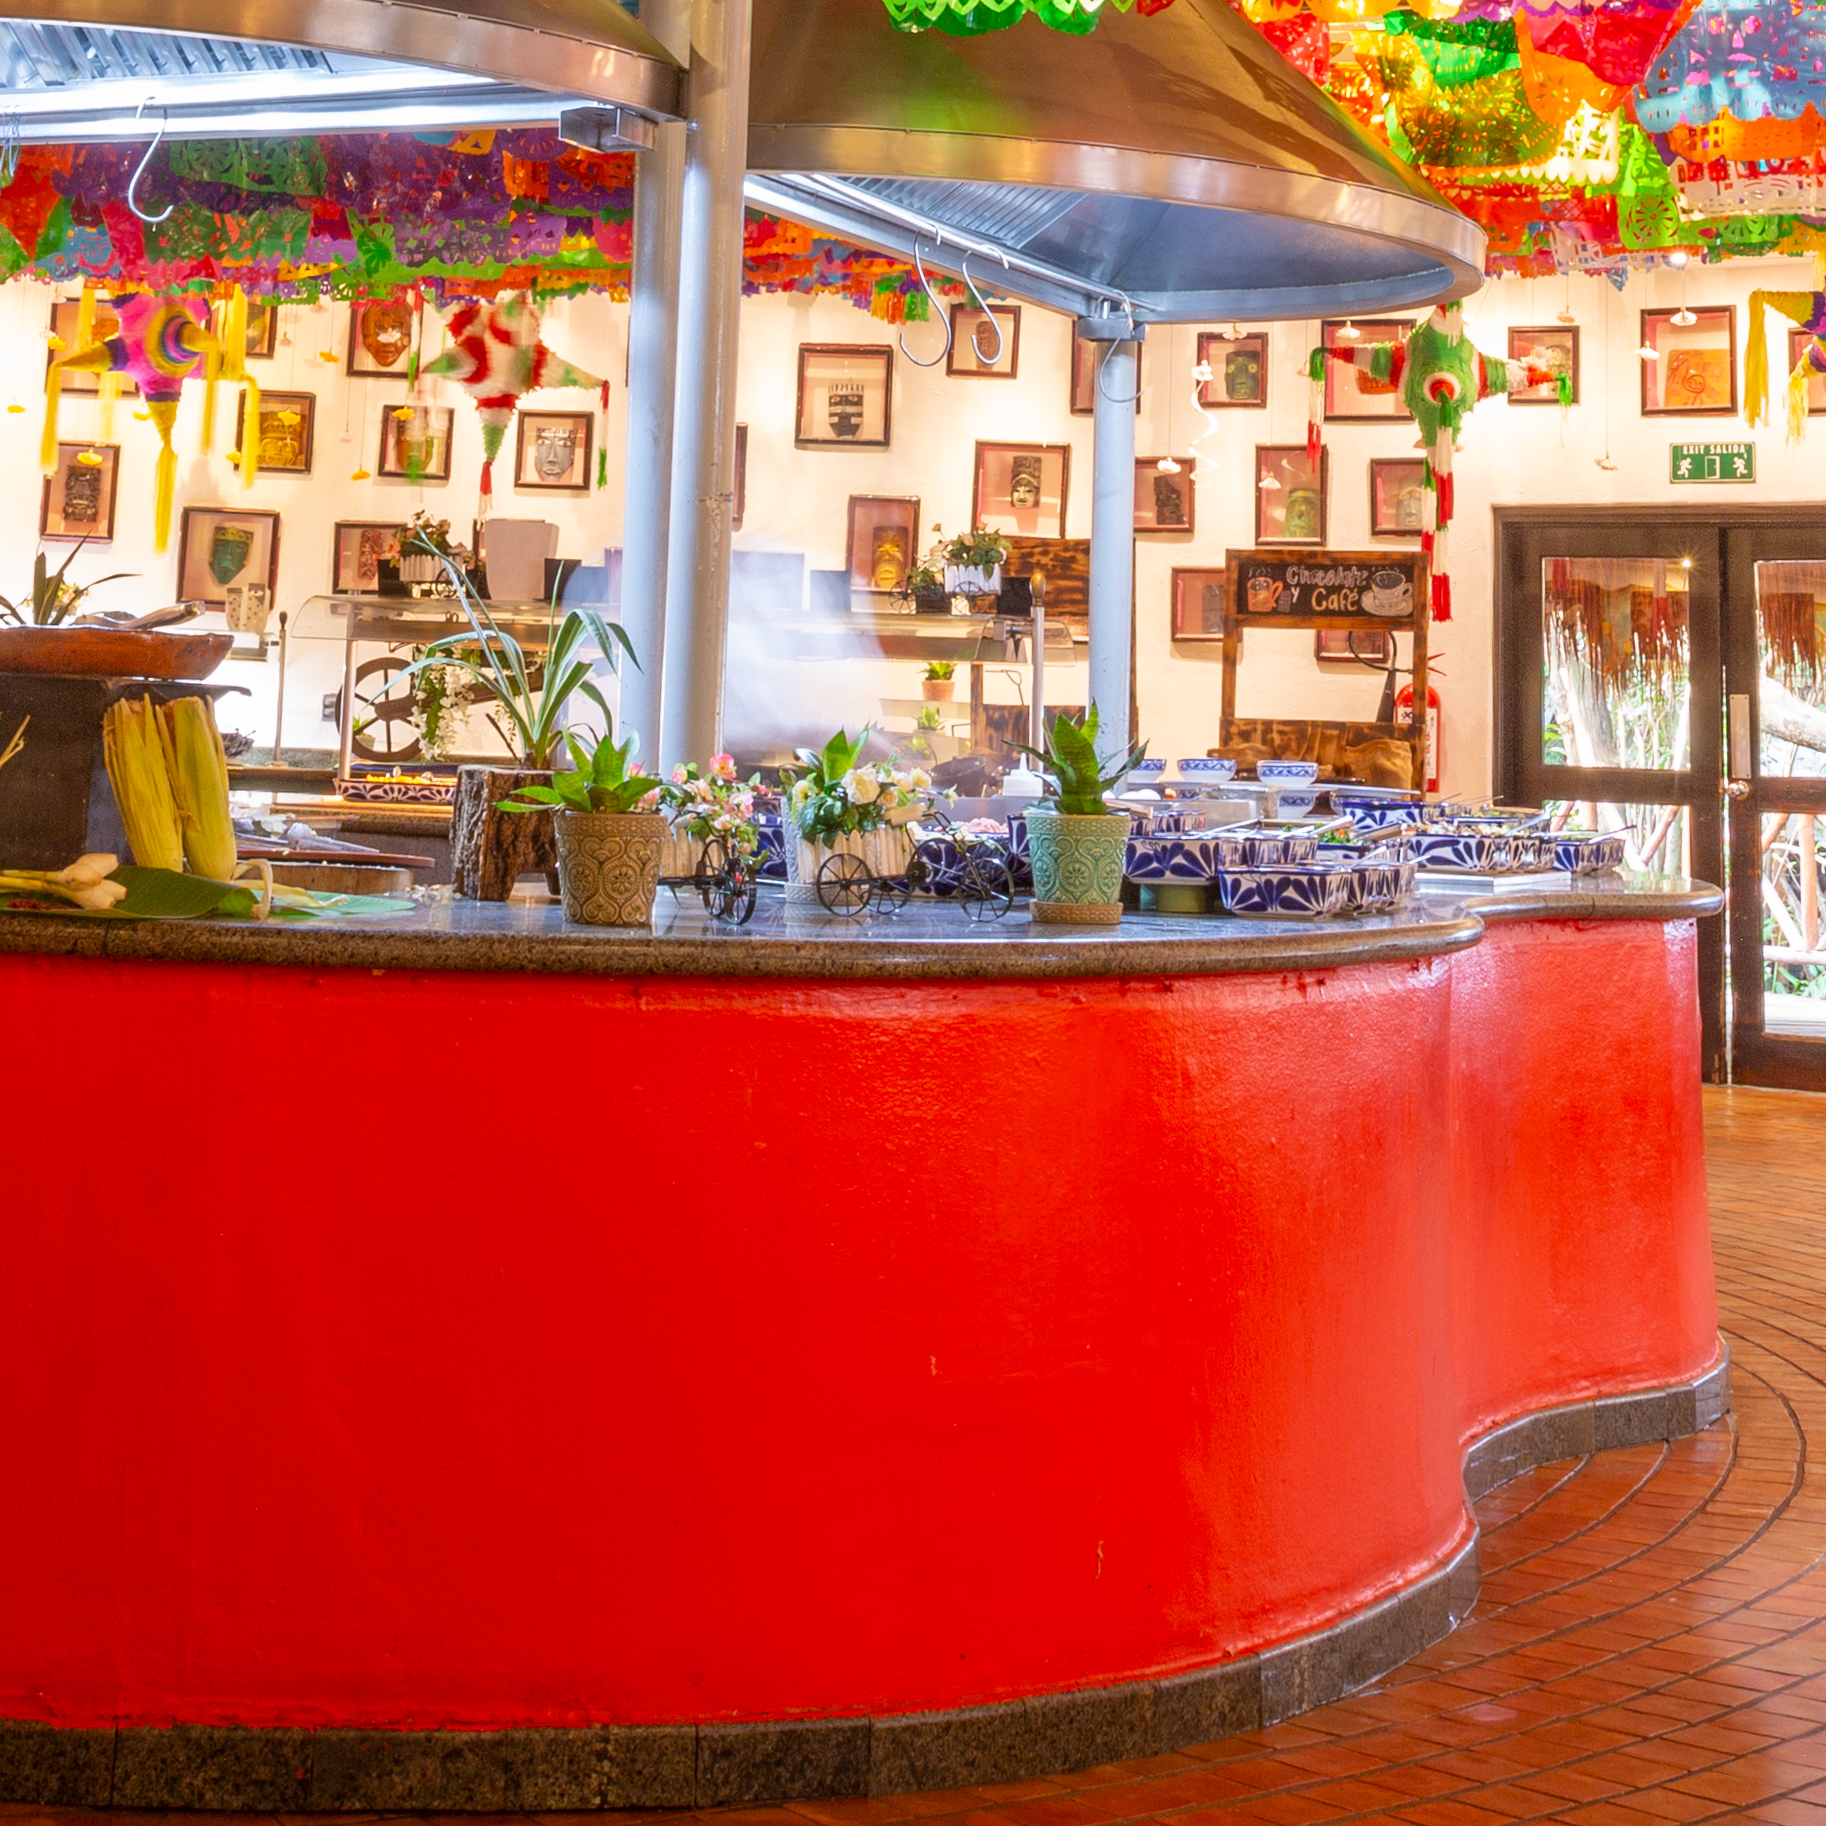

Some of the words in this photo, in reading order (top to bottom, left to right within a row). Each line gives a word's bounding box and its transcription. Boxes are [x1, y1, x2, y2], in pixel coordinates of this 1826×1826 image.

[1683, 445, 1705, 455] EXIT
[1709, 444, 1746, 454] SALIDA
[1311, 587, 1359, 611] Café
